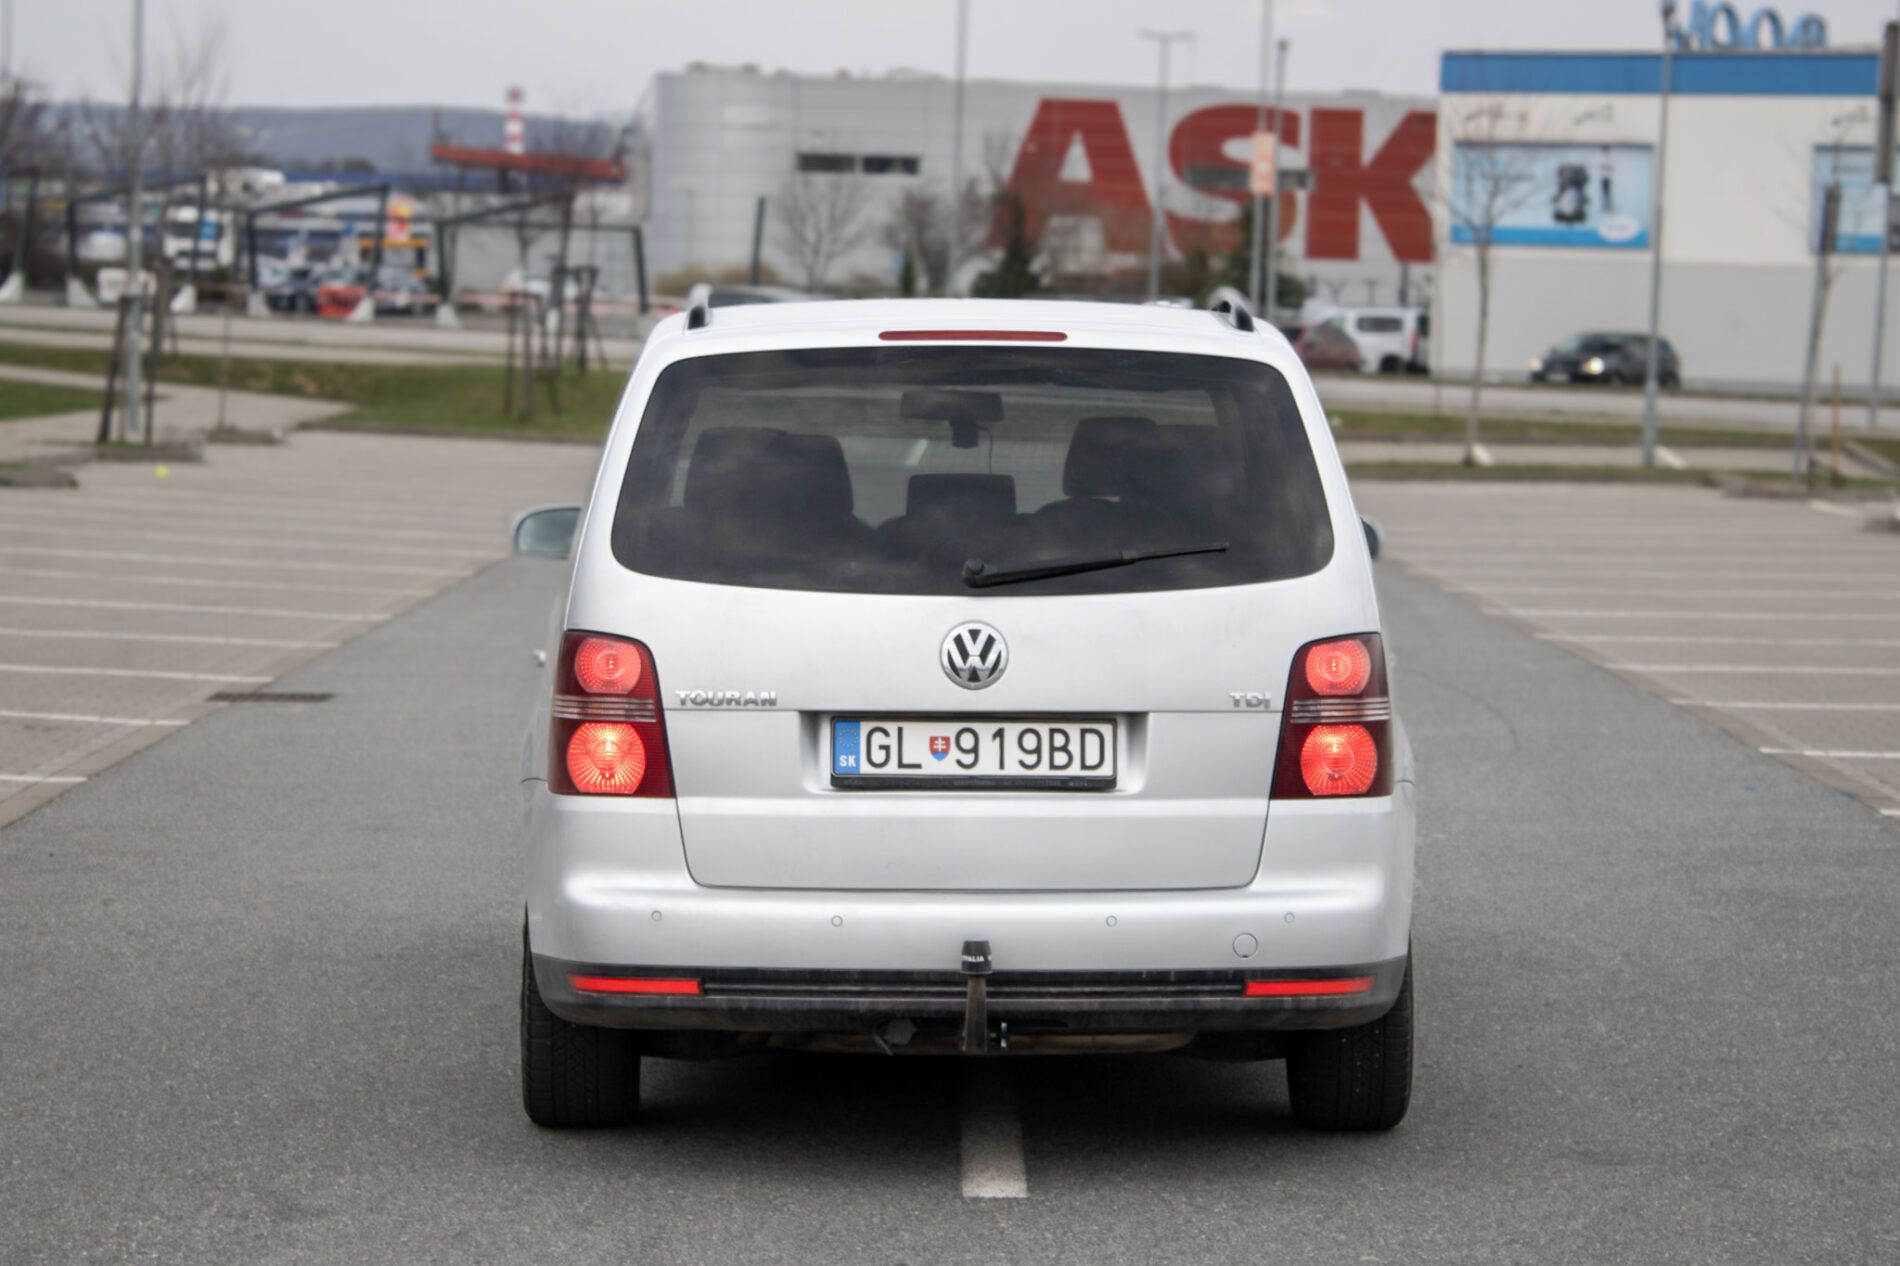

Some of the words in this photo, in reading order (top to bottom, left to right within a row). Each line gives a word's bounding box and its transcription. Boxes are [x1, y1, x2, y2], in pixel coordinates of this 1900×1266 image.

[987, 97, 1438, 263] ASK
[943, 624, 1005, 686] VW
[676, 689, 778, 706] TOURAN
[1229, 692, 1271, 709] TDI
[839, 755, 856, 768] SK
[866, 726, 922, 769] GL
[955, 727, 1105, 770] 919BD
